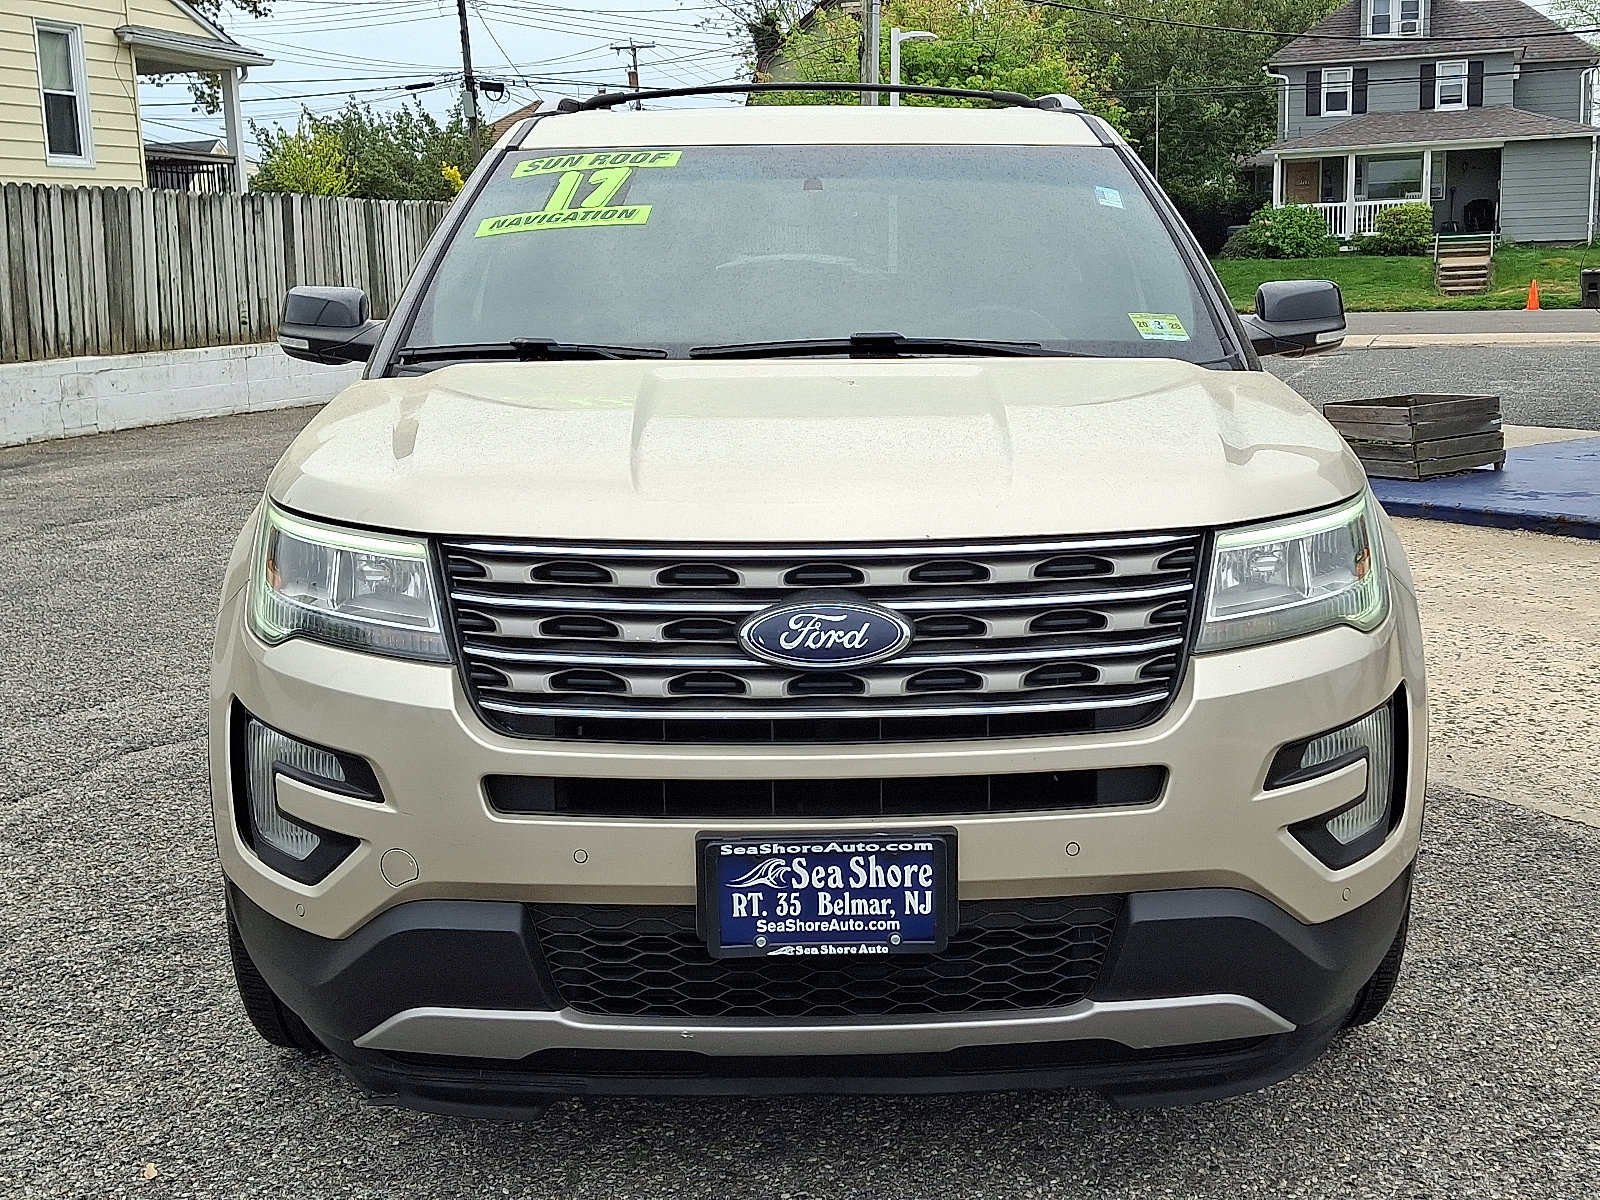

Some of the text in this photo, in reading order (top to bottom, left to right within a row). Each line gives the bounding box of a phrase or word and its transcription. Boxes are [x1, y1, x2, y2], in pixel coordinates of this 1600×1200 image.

[523, 152, 673, 173] SUN ROOF
[543, 166, 633, 211] 17
[488, 208, 640, 230] NAVIGATION
[1153, 320, 1164, 330] 3
[779, 613, 871, 650] Ford
[720, 842, 934, 855] SeaShoreAuto.com
[791, 855, 933, 889] Sea Shore
[731, 890, 933, 918] RT. 35 Belmar, NJ
[756, 918, 901, 933] SeaShoreAuto.com
[795, 943, 889, 955] Sea Shore Auto
